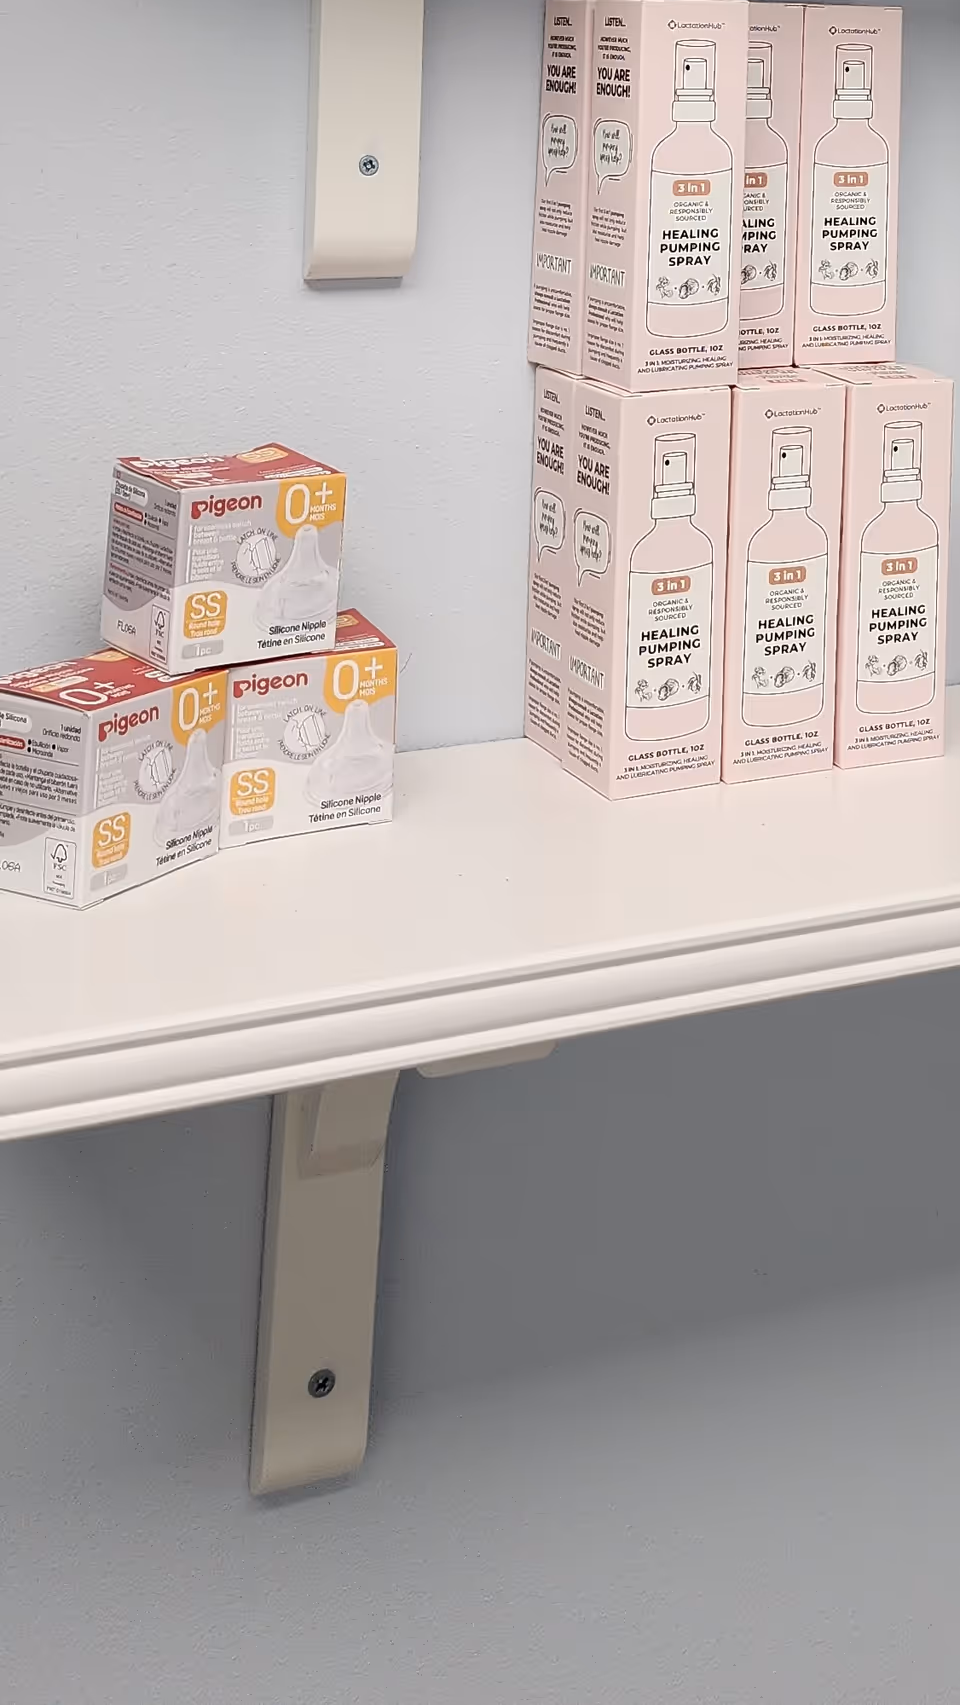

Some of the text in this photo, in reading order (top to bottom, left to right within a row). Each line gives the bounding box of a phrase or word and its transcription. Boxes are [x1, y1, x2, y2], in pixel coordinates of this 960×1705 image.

[547, 65, 576, 79] YOU ARE
[598, 67, 630, 82] YOU ARE
[546, 80, 576, 94] ENOUGH!
[597, 83, 630, 98] ENOUGH!
[678, 183, 685, 193] 3
[701, 182, 705, 192] 1
[824, 217, 876, 226] HEALING
[662, 228, 719, 240] HEALING
[822, 229, 877, 238] PUMPING
[660, 242, 720, 252] PUMPING
[830, 242, 869, 251] SPRAY
[536, 253, 571, 275] IMPORTANT
[669, 256, 711, 266] SPRAY
[590, 264, 625, 287] IMPORTANT
[813, 324, 835, 332] GLASS
[838, 324, 867, 332] BOTTLE,
[649, 347, 674, 356] GLASS
[676, 345, 707, 354] BOTTLE,
[310, 504, 337, 512] MONTHS
[190, 592, 221, 619] SS
[872, 605, 925, 618] HEALING
[269, 620, 326, 635] Silicone Nipple
[758, 615, 814, 629] HEALING
[869, 618, 927, 632] PUMPING
[295, 634, 325, 643] Silicone
[641, 625, 699, 641] HEALING
[756, 628, 815, 643] PUMPING
[877, 632, 919, 644] SPRAY
[639, 639, 700, 655] PUMPING
[765, 643, 806, 656] SPRAY
[648, 653, 691, 667] SPRAY
[237, 770, 269, 796] SS
[320, 793, 381, 809] Silicone Nipple
[349, 806, 380, 817] Silicone
[98, 815, 125, 845] SS
[166, 825, 213, 850] Silicone Nipple
[177, 849, 185, 858] en
[187, 838, 212, 854] Silicone
